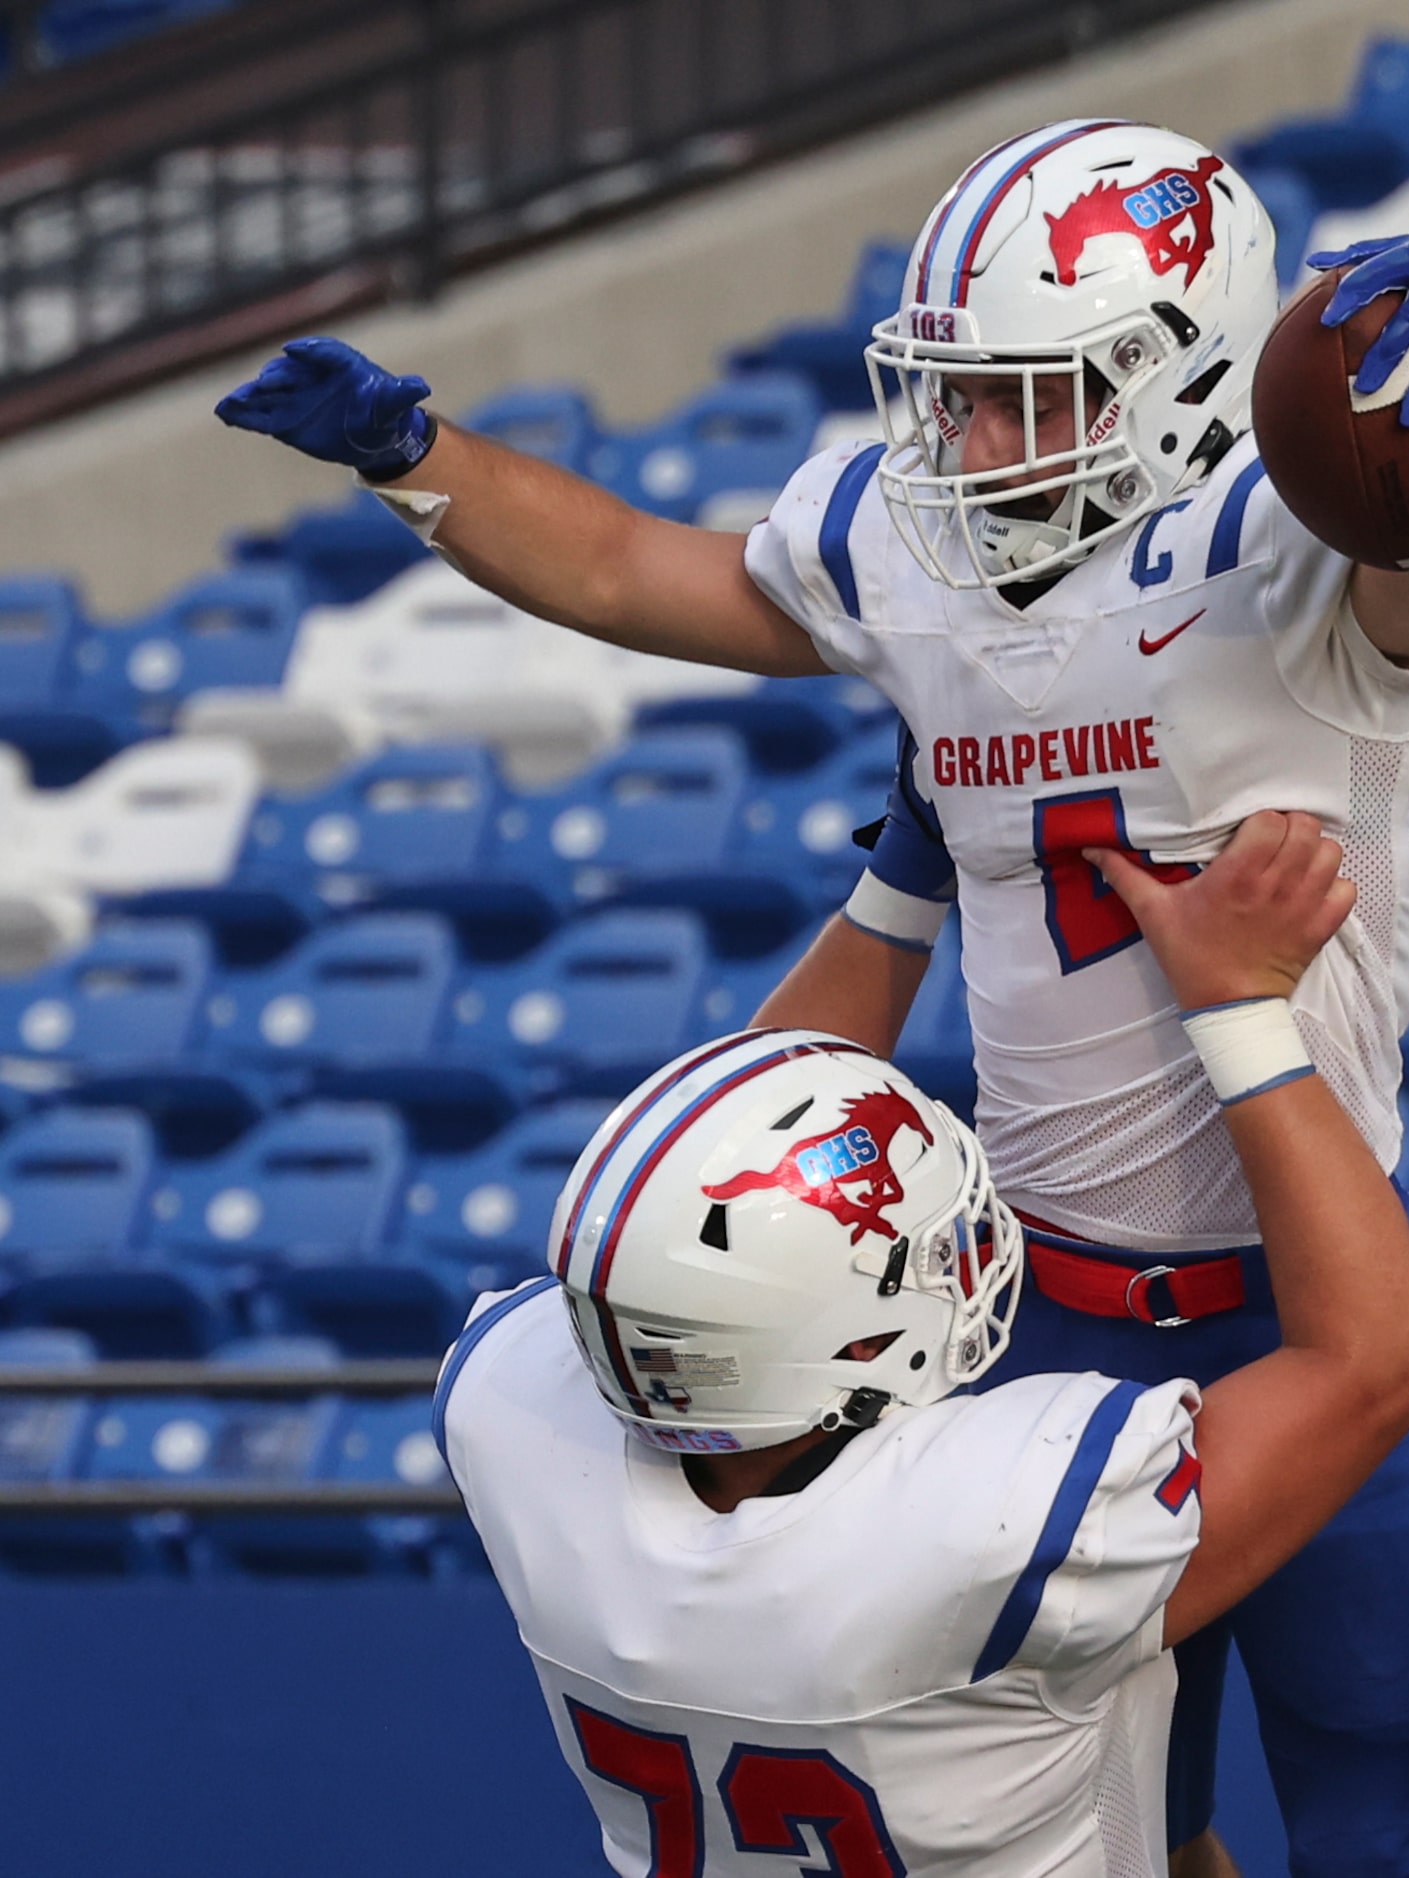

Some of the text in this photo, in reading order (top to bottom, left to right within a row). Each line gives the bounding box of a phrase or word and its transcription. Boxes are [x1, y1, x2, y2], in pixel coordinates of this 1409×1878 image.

[1122, 172, 1201, 229] GHS
[910, 310, 955, 343] 103
[1129, 498, 1194, 590] C
[933, 715, 1160, 788] GRAPEVINE
[795, 1124, 880, 1188] GHS
